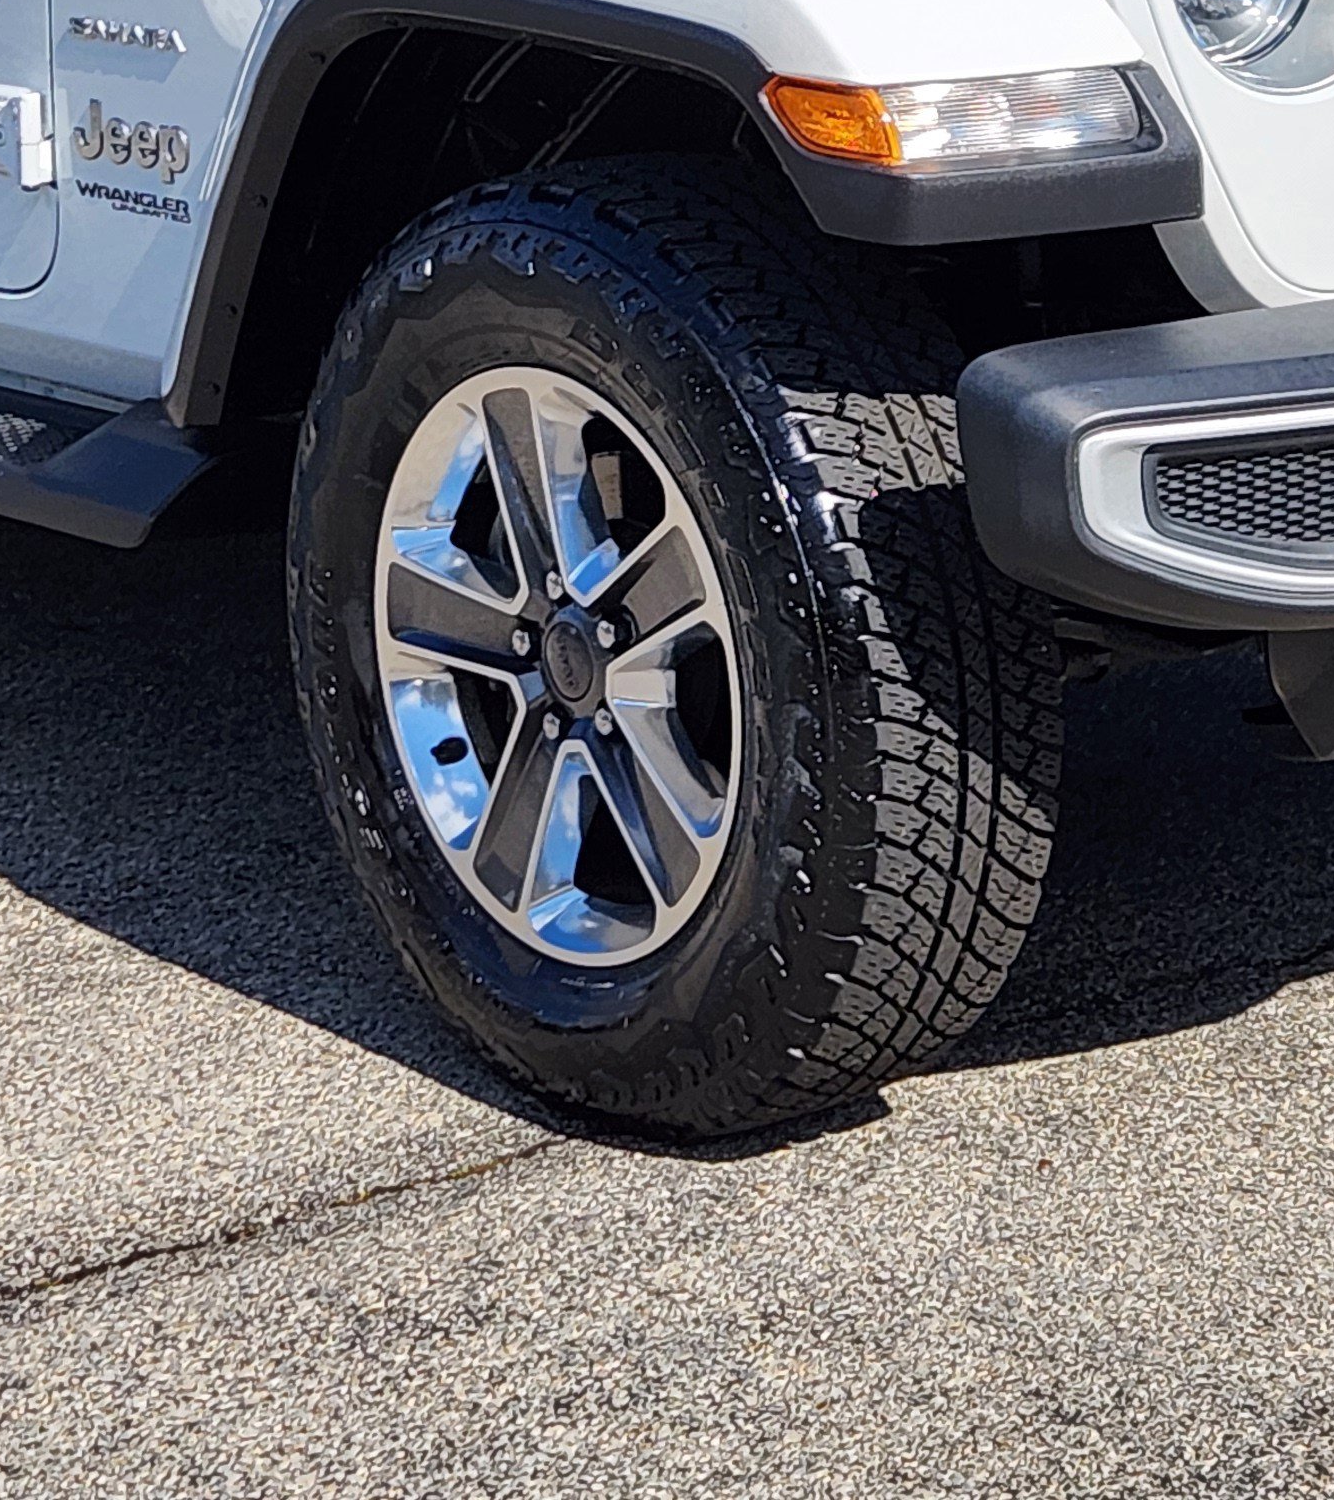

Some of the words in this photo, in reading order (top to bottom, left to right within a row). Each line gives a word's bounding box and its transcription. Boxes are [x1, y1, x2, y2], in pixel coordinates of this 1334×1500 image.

[72, 98, 190, 185] Jeep
[75, 179, 191, 215] WRANGLER
[111, 202, 192, 224] UNLIMITED
